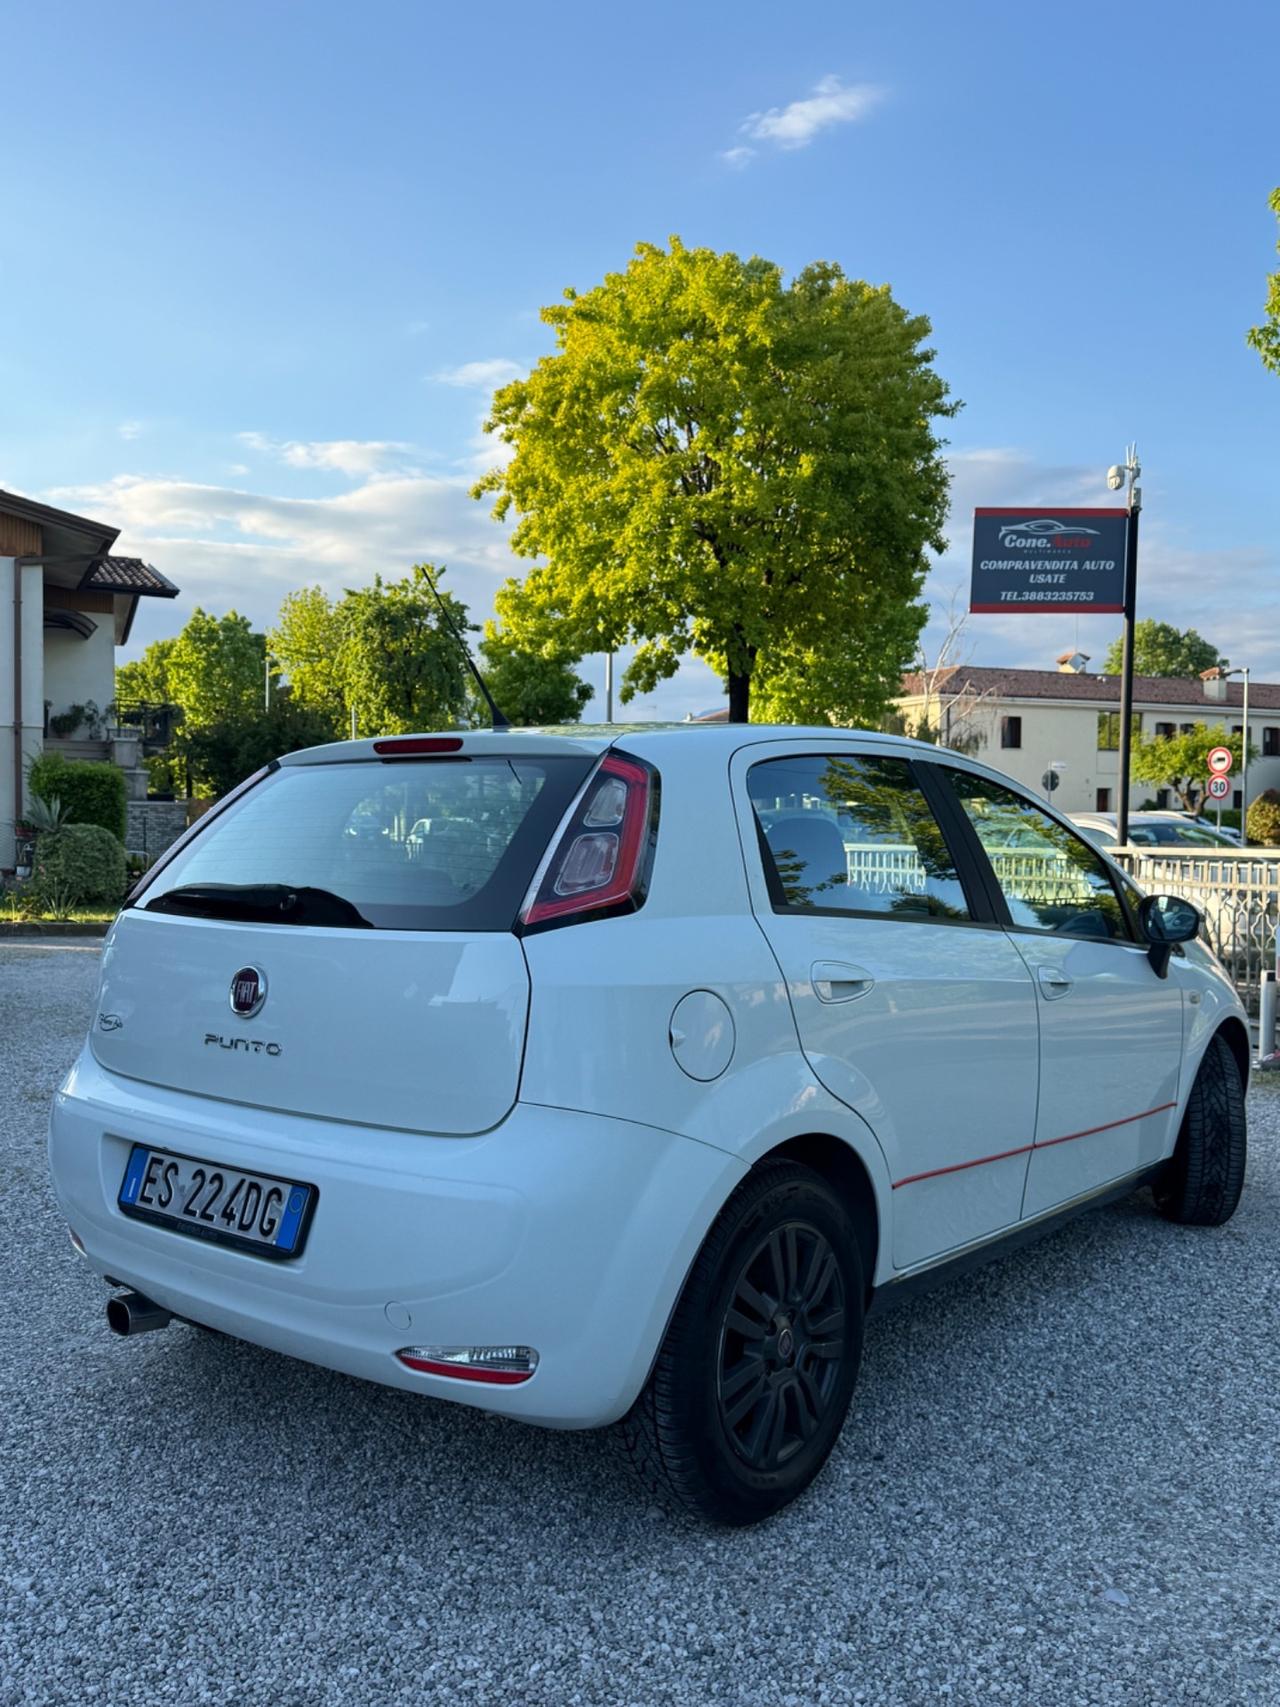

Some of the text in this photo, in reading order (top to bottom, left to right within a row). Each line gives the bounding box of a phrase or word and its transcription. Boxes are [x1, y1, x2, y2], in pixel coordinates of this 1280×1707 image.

[980, 560, 1115, 570] COMPRAVENDITA AUTO
[1029, 574, 1067, 583] USATE
[1213, 781, 1226, 793] 30
[236, 980, 257, 1004] FIAT
[204, 1033, 282, 1056] PUNTO
